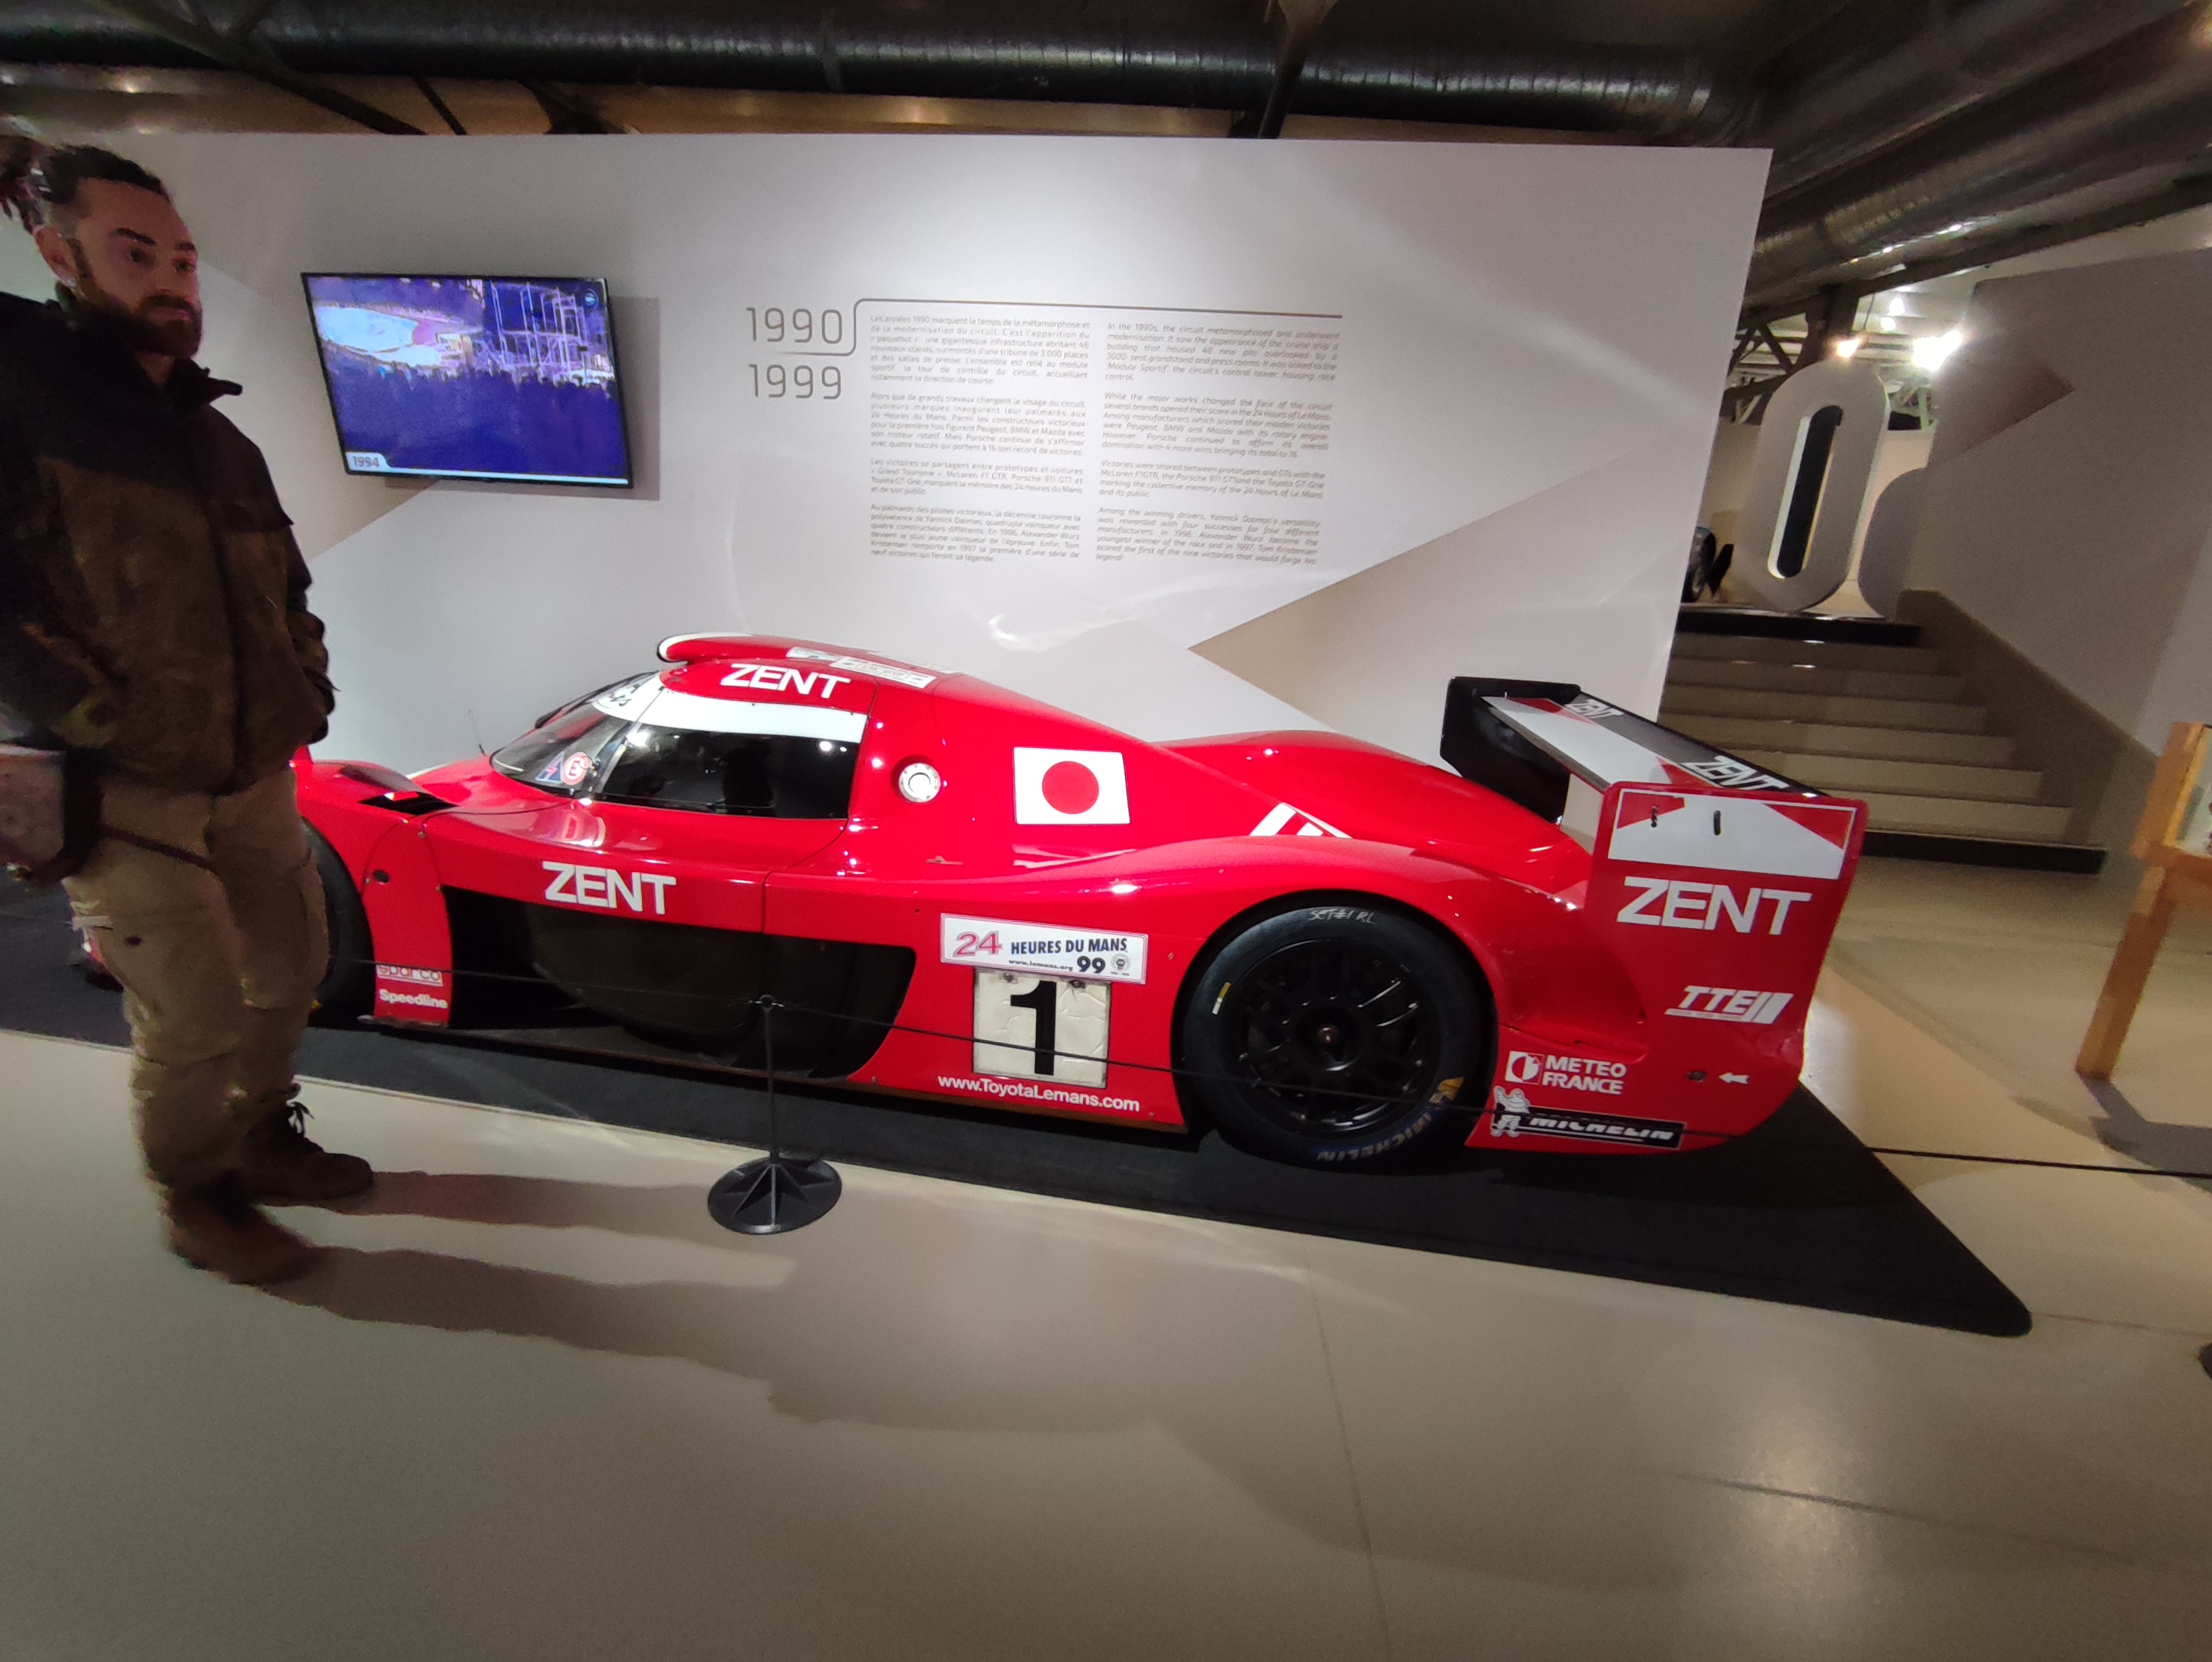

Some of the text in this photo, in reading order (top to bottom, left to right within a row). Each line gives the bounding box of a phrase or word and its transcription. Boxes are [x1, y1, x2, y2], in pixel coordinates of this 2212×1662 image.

[747, 308, 842, 344] 1990
[748, 364, 841, 399] 1999
[351, 456, 380, 467] 1994
[720, 663, 851, 699] ZENT
[1563, 698, 1626, 719] ZENT
[1680, 755, 1791, 791] ZENT
[542, 861, 676, 915] ZENT
[1617, 876, 1813, 936] ZENT
[952, 931, 1128, 957] 24 HEURES DU MANS
[1077, 956, 1105, 973] 99
[379, 988, 448, 1008] Speedline
[1679, 985, 1762, 1014] TTE
[1010, 980, 1057, 1075] 1
[1545, 1055, 1627, 1078] METEO
[937, 1075, 1140, 1112] www.ToyotaLemans.com
[1542, 1071, 1624, 1095] FRANCE
